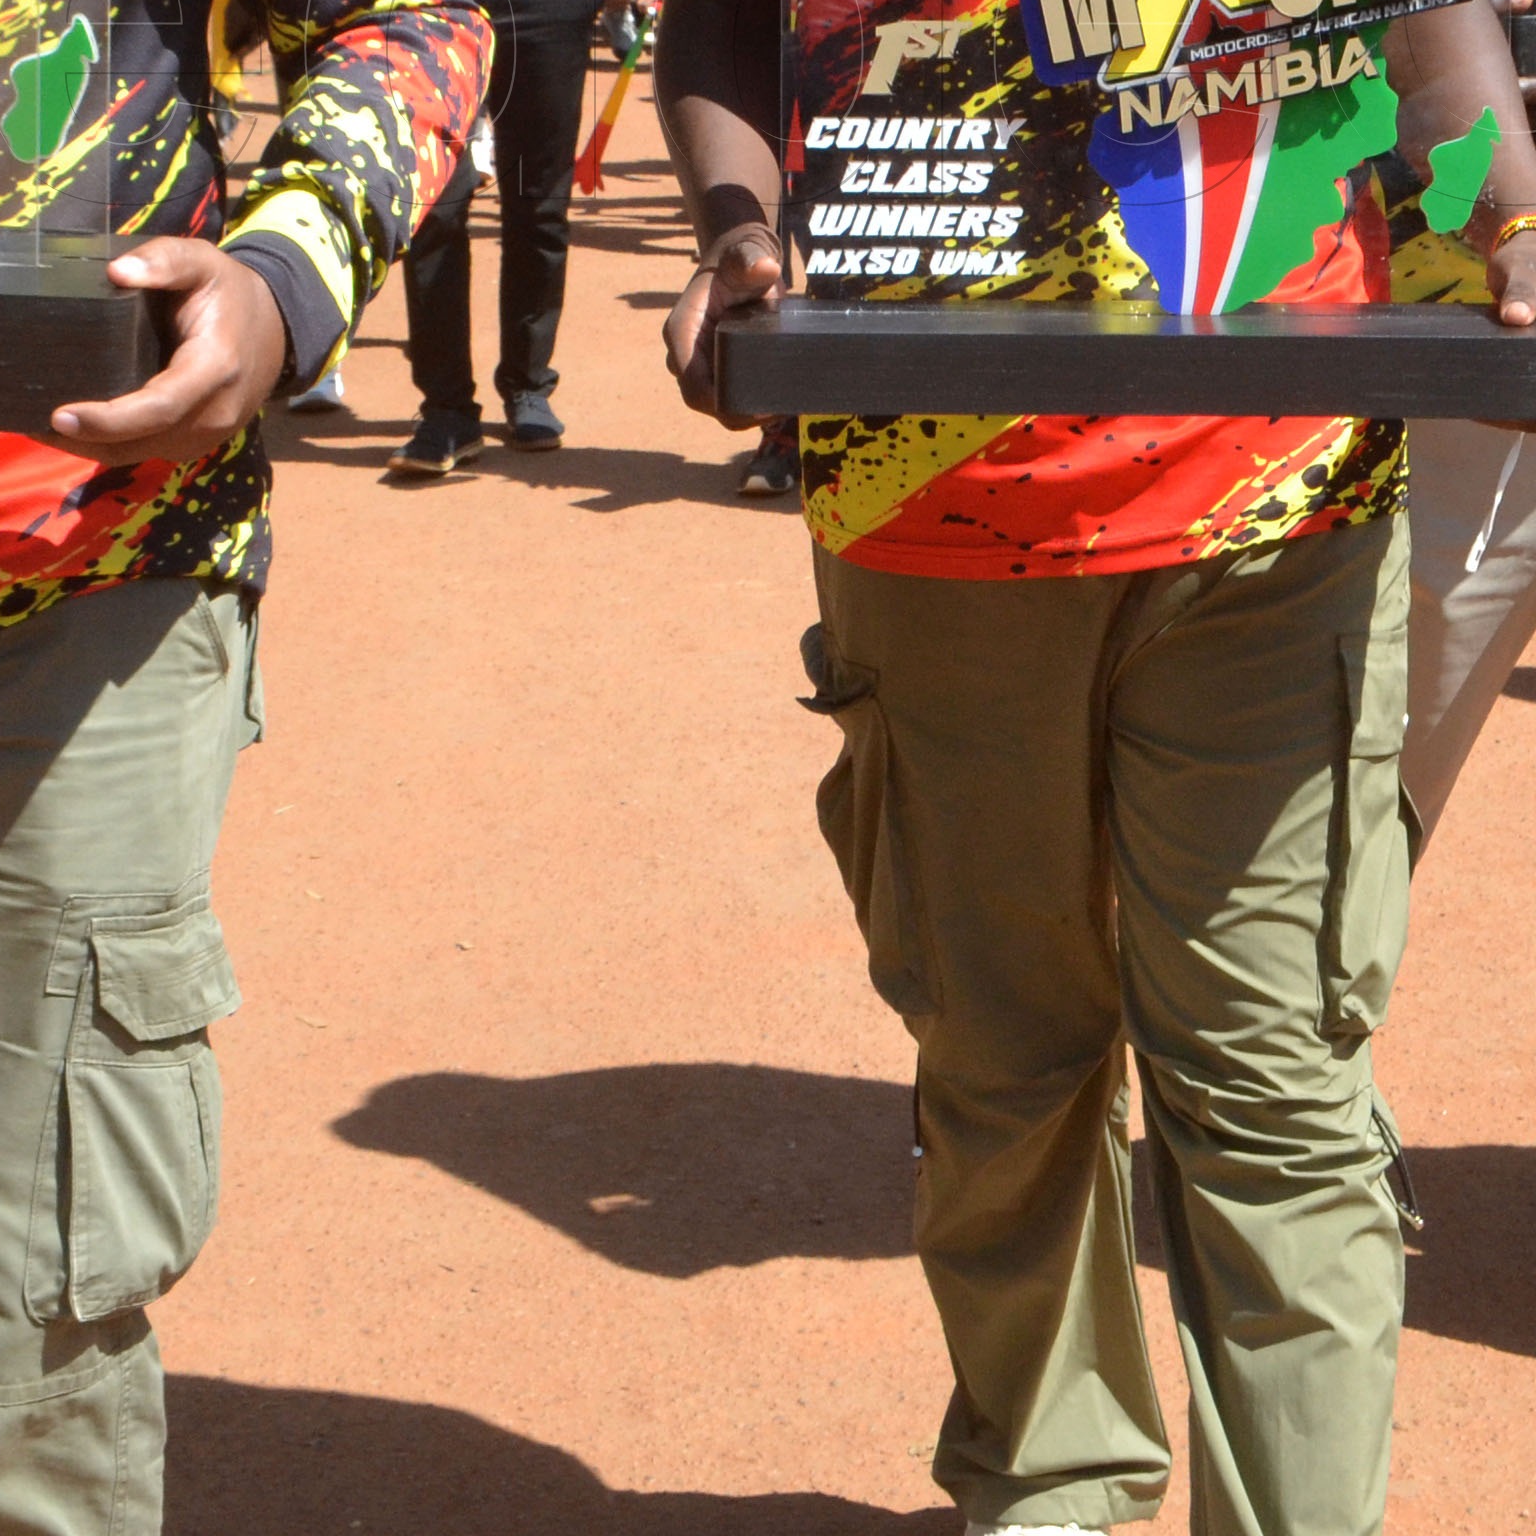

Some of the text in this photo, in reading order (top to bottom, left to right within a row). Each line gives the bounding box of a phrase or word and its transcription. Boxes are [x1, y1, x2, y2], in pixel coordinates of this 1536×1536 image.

[1189, 27, 1289, 63] MOTOCROSS
[1291, 20, 1312, 39] OF
[1313, 9, 1383, 36] AFRICAN
[804, 116, 1028, 150] COUNTRY
[839, 160, 995, 194] CLASS
[807, 203, 1024, 238] WINNERS
[928, 249, 1027, 276] WMX
